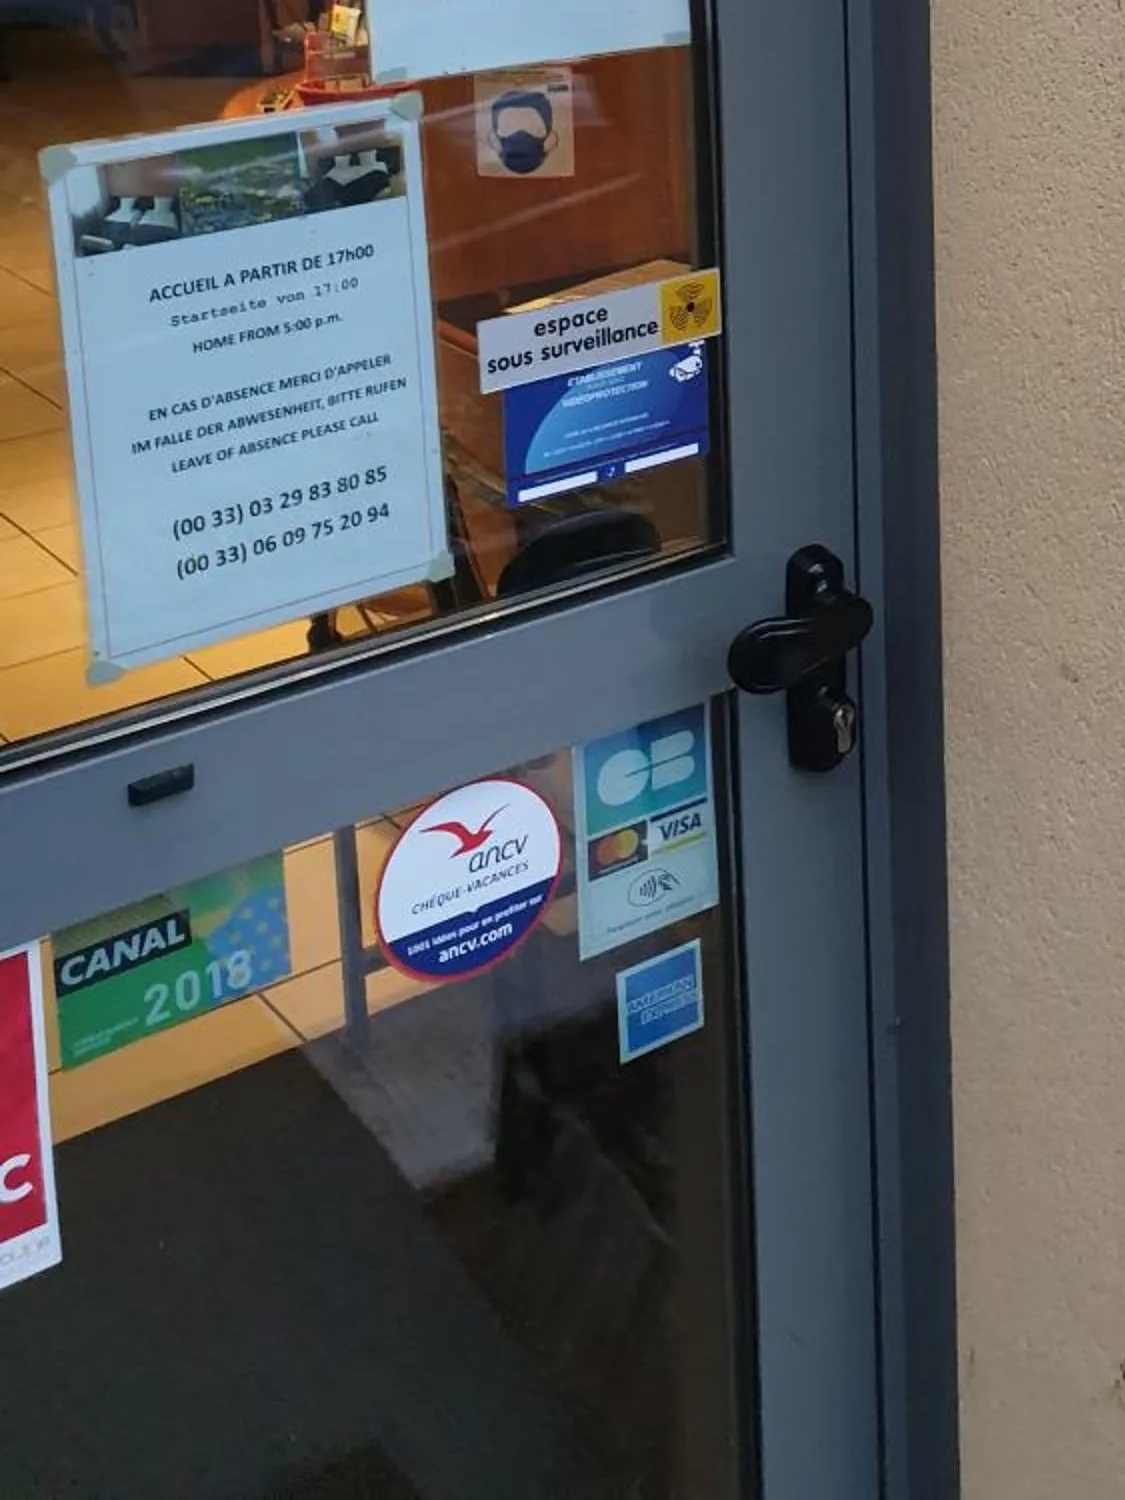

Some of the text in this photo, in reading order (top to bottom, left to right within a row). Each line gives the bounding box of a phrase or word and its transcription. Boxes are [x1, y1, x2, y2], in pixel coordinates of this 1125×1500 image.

[148, 243, 375, 304] ACCUEIL A PARTIR DE 17h00
[170, 276, 359, 328] Startseite von 17:00
[192, 332, 237, 355] HOME
[239, 323, 282, 344] FROM
[284, 316, 313, 335] 5:00
[487, 319, 659, 376] sous surveillance
[533, 305, 609, 340] espace
[131, 376, 408, 455] IM FALLE DER ABWESENHEIT, BITTE RUFEN
[148, 352, 392, 422] EN CAS D'ABSENCE MERCI D'APPELER
[171, 410, 380, 475] LEAVE OF ABSENCE PLEASE CALL
[172, 465, 388, 542] (00 33) 03 29 83 80 85
[176, 502, 390, 582] (00 33) 06 09 75 20 94
[468, 833, 529, 874] ancv
[659, 811, 703, 843] VISA
[59, 918, 187, 986] CANAL
[438, 923, 513, 963] ancv.com
[142, 949, 252, 1028] 2018
